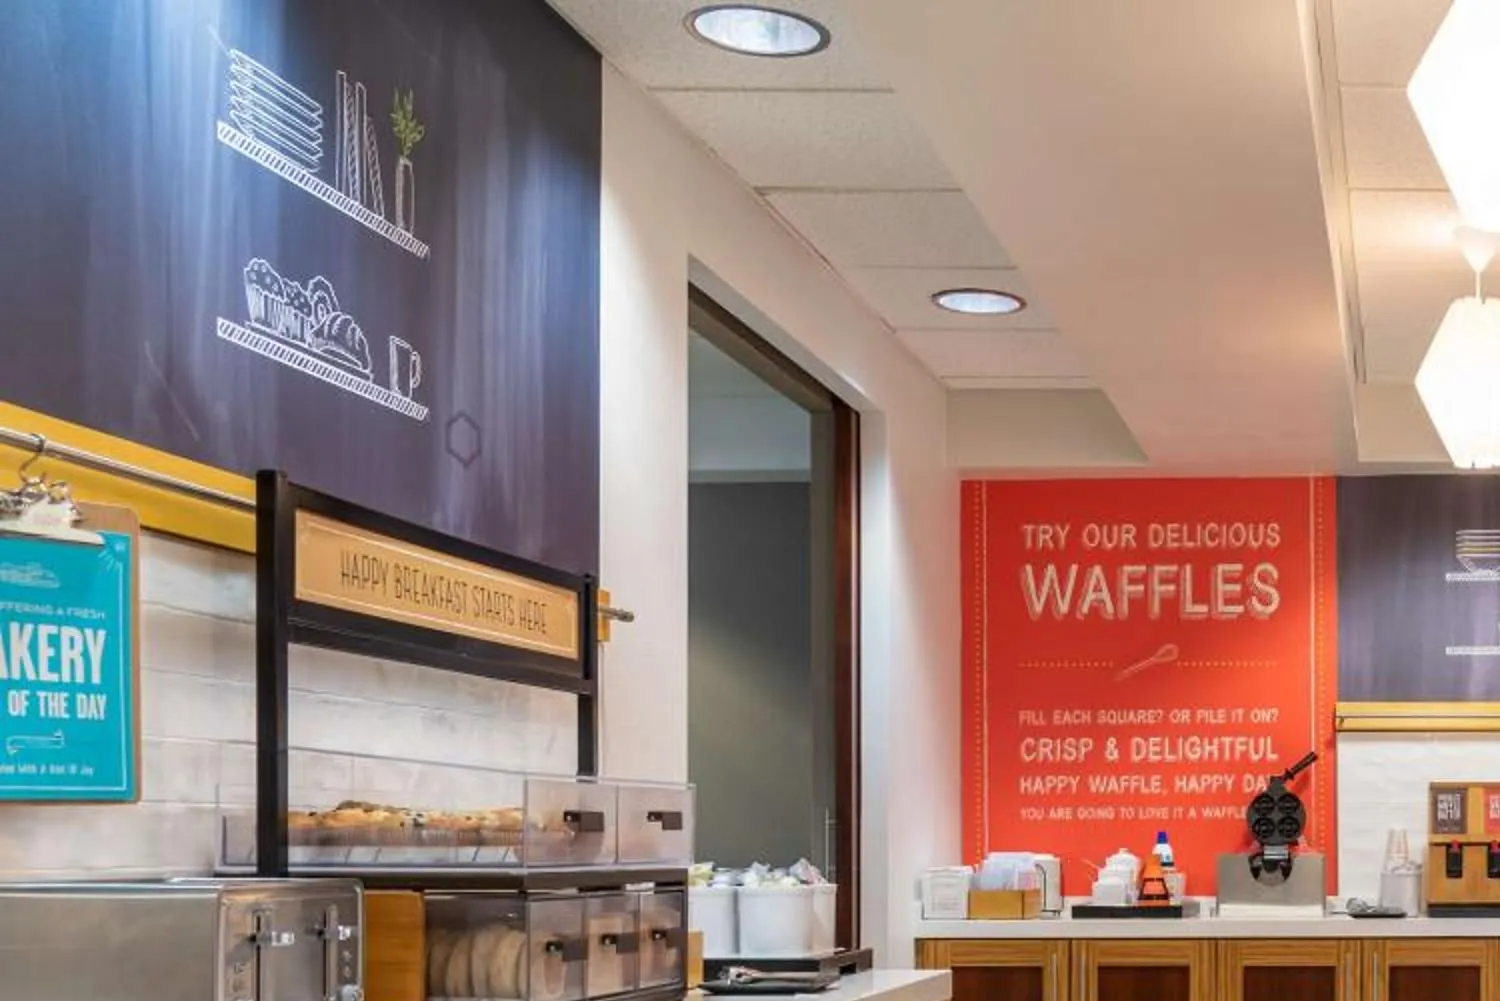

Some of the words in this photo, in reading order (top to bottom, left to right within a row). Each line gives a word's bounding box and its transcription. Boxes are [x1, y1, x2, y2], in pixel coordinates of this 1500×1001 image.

[1023, 523, 1070, 549] TRY
[1082, 522, 1137, 549] OUR
[1150, 522, 1281, 548] DELICIOUS
[340, 550, 389, 597] HAPPY
[394, 562, 468, 615] BREAKFAST
[472, 584, 515, 627] STARTS
[518, 598, 548, 635] HERE
[1020, 561, 1282, 622] WAFFLES
[7, 689, 30, 717] OF
[36, 690, 71, 719] THE
[76, 692, 107, 720] DAY
[1018, 709, 1047, 726] FILL
[1053, 708, 1092, 725] EACH
[1097, 708, 1163, 725] SQUARE?
[1169, 708, 1191, 724] OR
[1196, 707, 1227, 724] PILE
[1231, 707, 1245, 723] IT
[1250, 705, 1279, 723] ON?
[1020, 736, 1094, 762] CRISP
[1104, 736, 1120, 761] &
[1130, 735, 1279, 762] DELIGHTFUL
[1020, 774, 1081, 796] HAPPY
[1088, 774, 1168, 797] WAFFLE,
[1174, 773, 1235, 794] HAPPY
[1243, 773, 1272, 795] DA
[1020, 805, 1045, 820] YOU
[1048, 805, 1073, 820] ARE
[1077, 805, 1115, 820] GOING
[1119, 805, 1135, 820] TO
[1138, 805, 1169, 820] LOVE
[1173, 805, 1185, 820] IT
[1188, 805, 1197, 819] A
